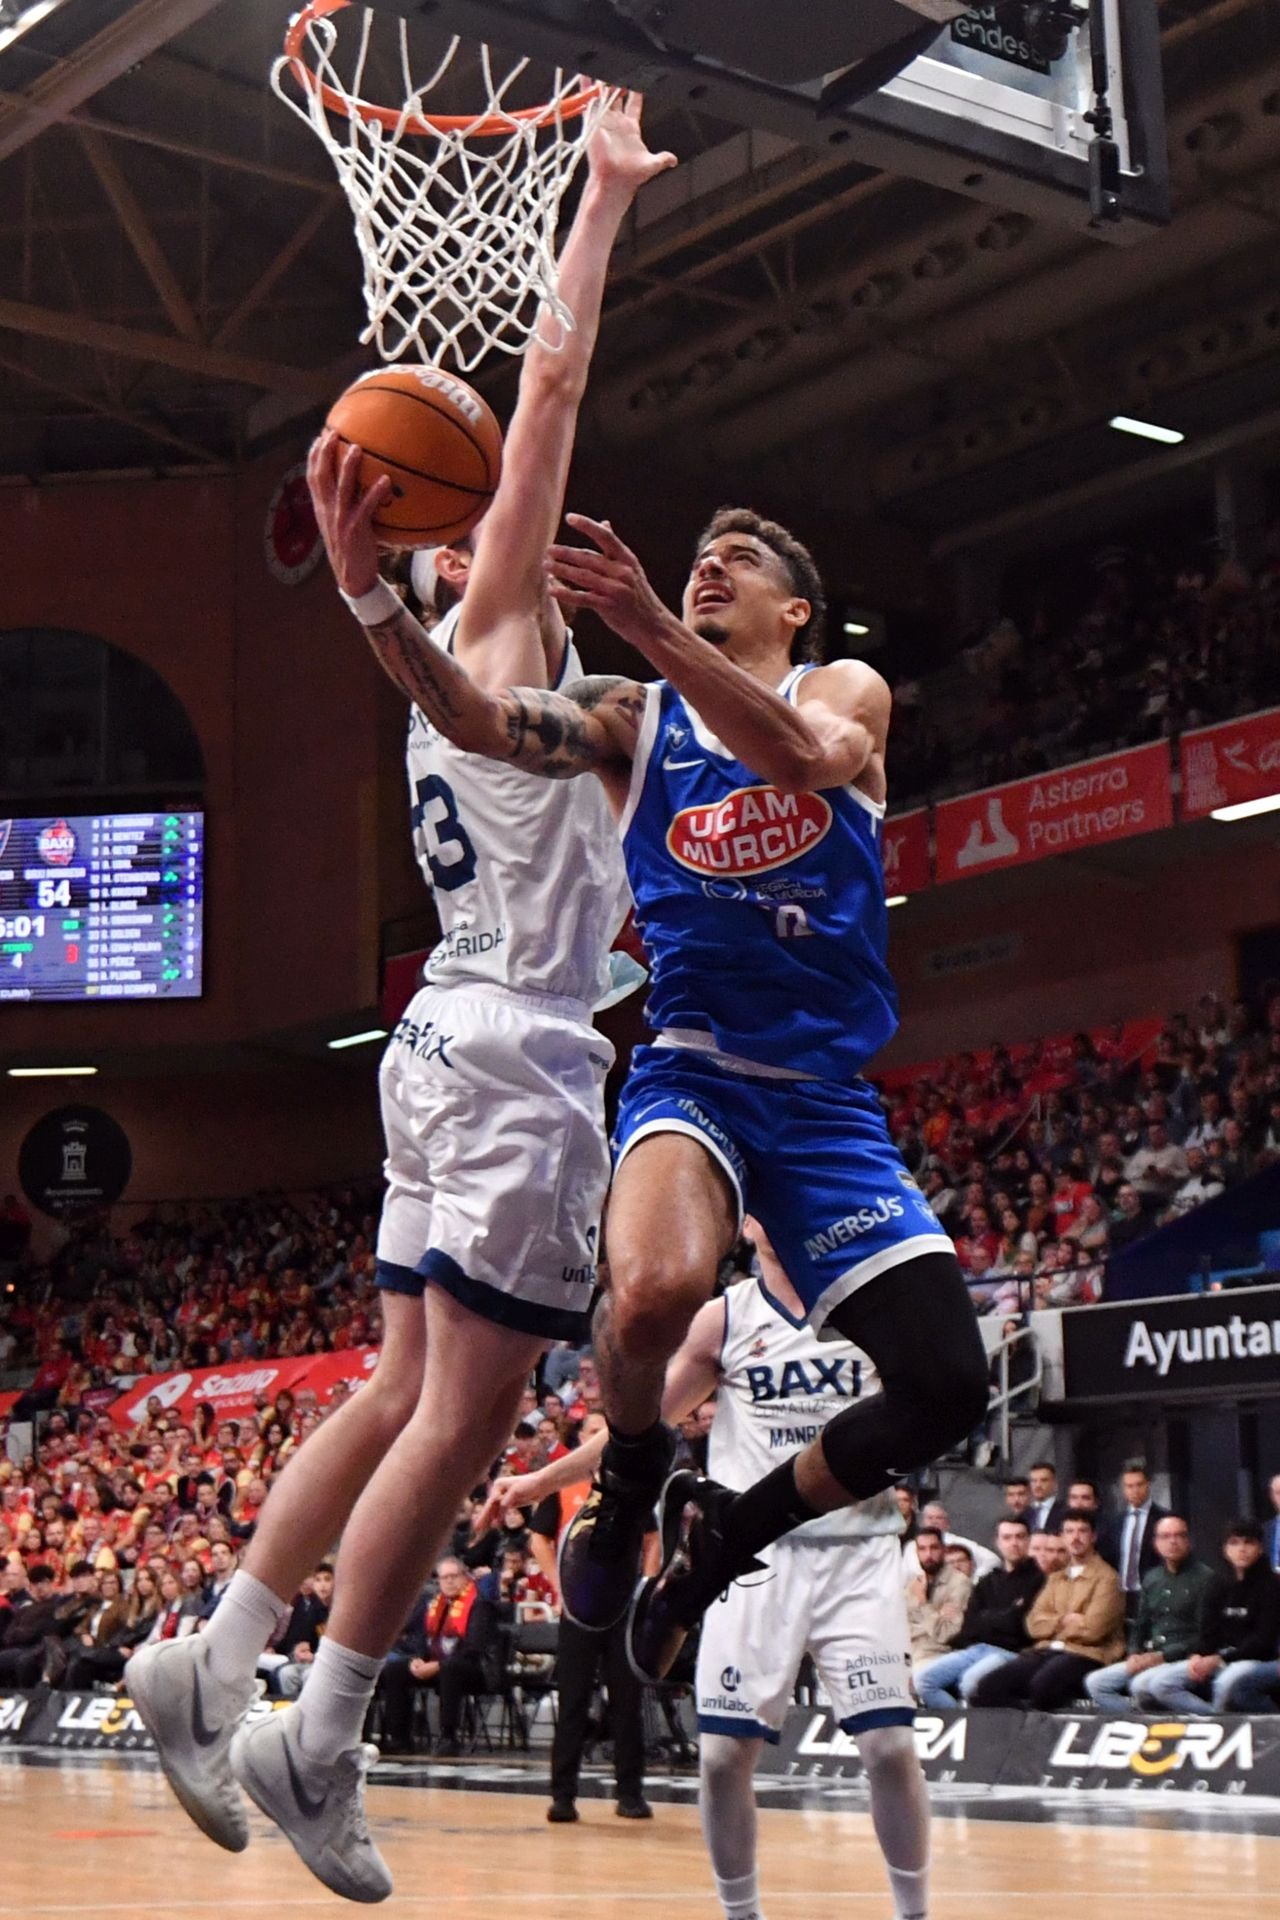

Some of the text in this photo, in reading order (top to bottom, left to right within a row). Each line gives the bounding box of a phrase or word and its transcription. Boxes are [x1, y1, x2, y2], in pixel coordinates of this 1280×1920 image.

[955, 18, 1046, 66] endes
[1028, 766, 1129, 813] Asterra
[412, 774, 478, 892] 3
[690, 791, 799, 838] UCAM
[1028, 798, 1145, 850] Partners
[682, 818, 820, 869] MURCIA
[38, 879, 71, 908] 54
[803, 1195, 905, 1261] INVERSUS
[1123, 1314, 1280, 1377] Ayunta
[745, 1358, 862, 1403] BAXI
[847, 1669, 878, 1690] ETL
[850, 1687, 906, 1706] GLOBAL
[1050, 1720, 1253, 1777] LIBERA
